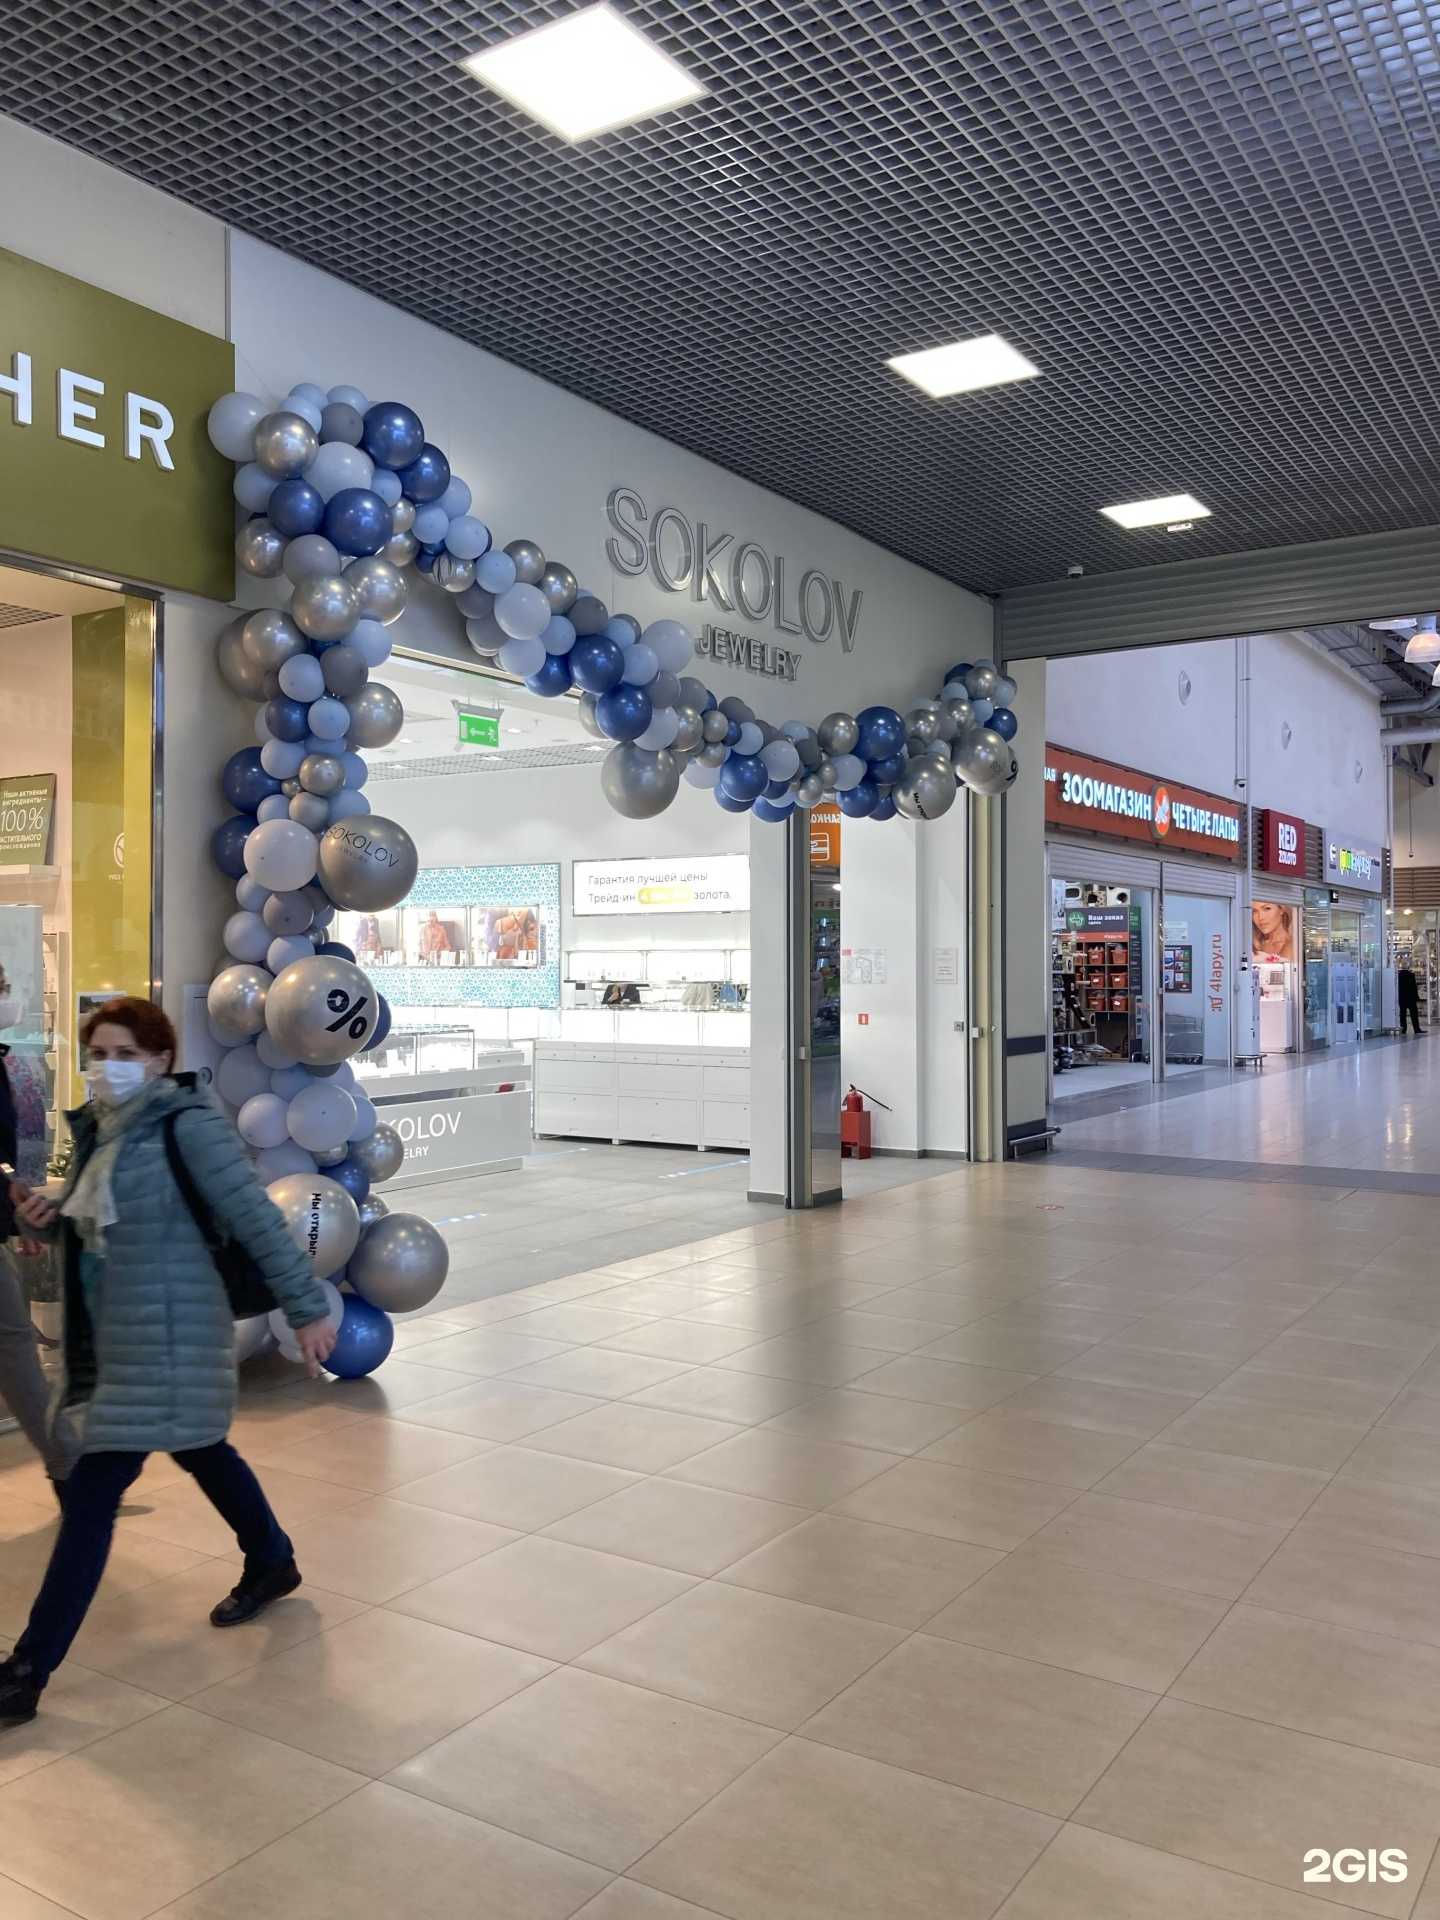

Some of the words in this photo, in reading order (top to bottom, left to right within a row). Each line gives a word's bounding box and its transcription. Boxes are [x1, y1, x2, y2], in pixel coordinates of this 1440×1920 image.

[606, 487, 864, 654] SOKOLOV
[696, 623, 803, 682] JEWELRY
[1061, 771, 1153, 822] ЗООМАГАЗИН
[0, 806, 44, 832] 100%
[1172, 801, 1212, 836] ЧЕТЫРЕ
[1211, 812, 1240, 842] ЛАПЫ
[1278, 822, 1297, 851] RED
[326, 827, 400, 868] SOKOLOV
[588, 875, 635, 887] Гарантия
[637, 873, 677, 885] лучшей
[680, 873, 708, 883] цены
[588, 893, 635, 904] Трейд-ин
[1208, 934, 1225, 992] 4lapy.ru
[312, 1193, 322, 1210] Мы
[307, 1213, 320, 1256] открыл
